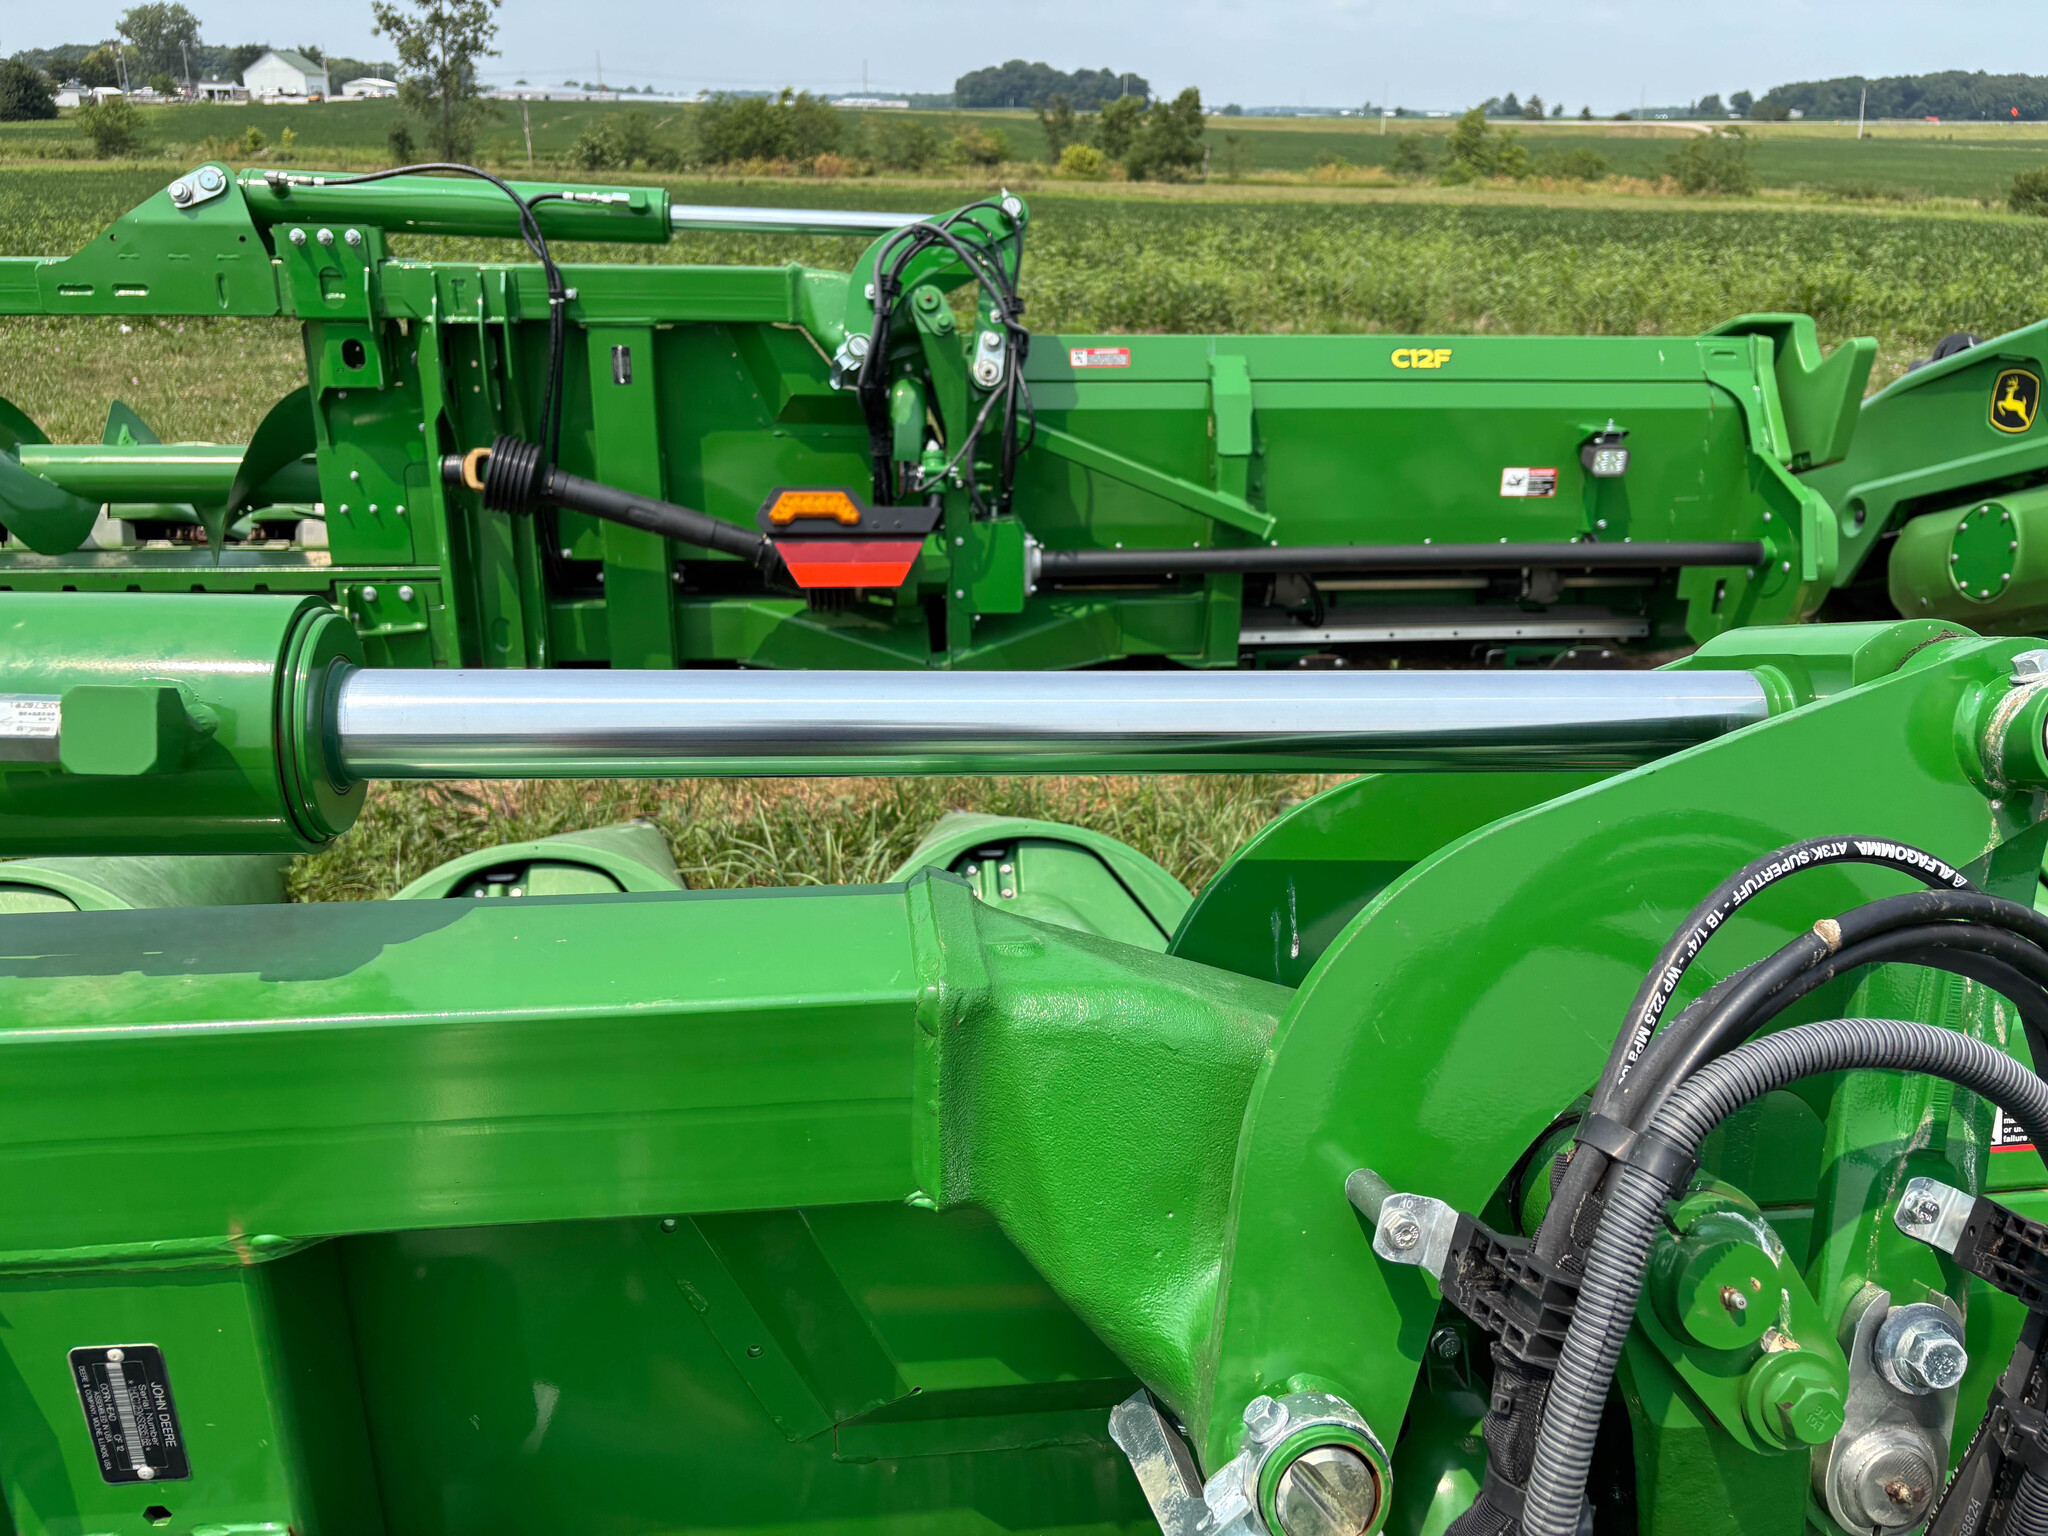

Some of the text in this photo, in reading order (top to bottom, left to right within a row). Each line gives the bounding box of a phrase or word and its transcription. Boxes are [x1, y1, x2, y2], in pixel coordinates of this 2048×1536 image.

[1391, 348, 1452, 368] C12F
[1814, 841, 1847, 860] AT3K
[1853, 841, 1953, 880] ALFAGOMMA
[1733, 850, 1814, 905] SUPERTUFF
[1705, 909, 1724, 929] 1B
[1687, 927, 1708, 958] 1/4"
[1663, 966, 1682, 993] WP
[1644, 990, 1666, 1026] 22.5
[1628, 1028, 1652, 1061] MPa
[78, 1365, 89, 1382] DEERE
[100, 1383, 111, 1403] CORN
[106, 1403, 116, 1422] HEAD
[138, 1384, 160, 1446] Serial Number
[151, 1381, 177, 1447] JOHN DEERE
[104, 1430, 112, 1443] USA
